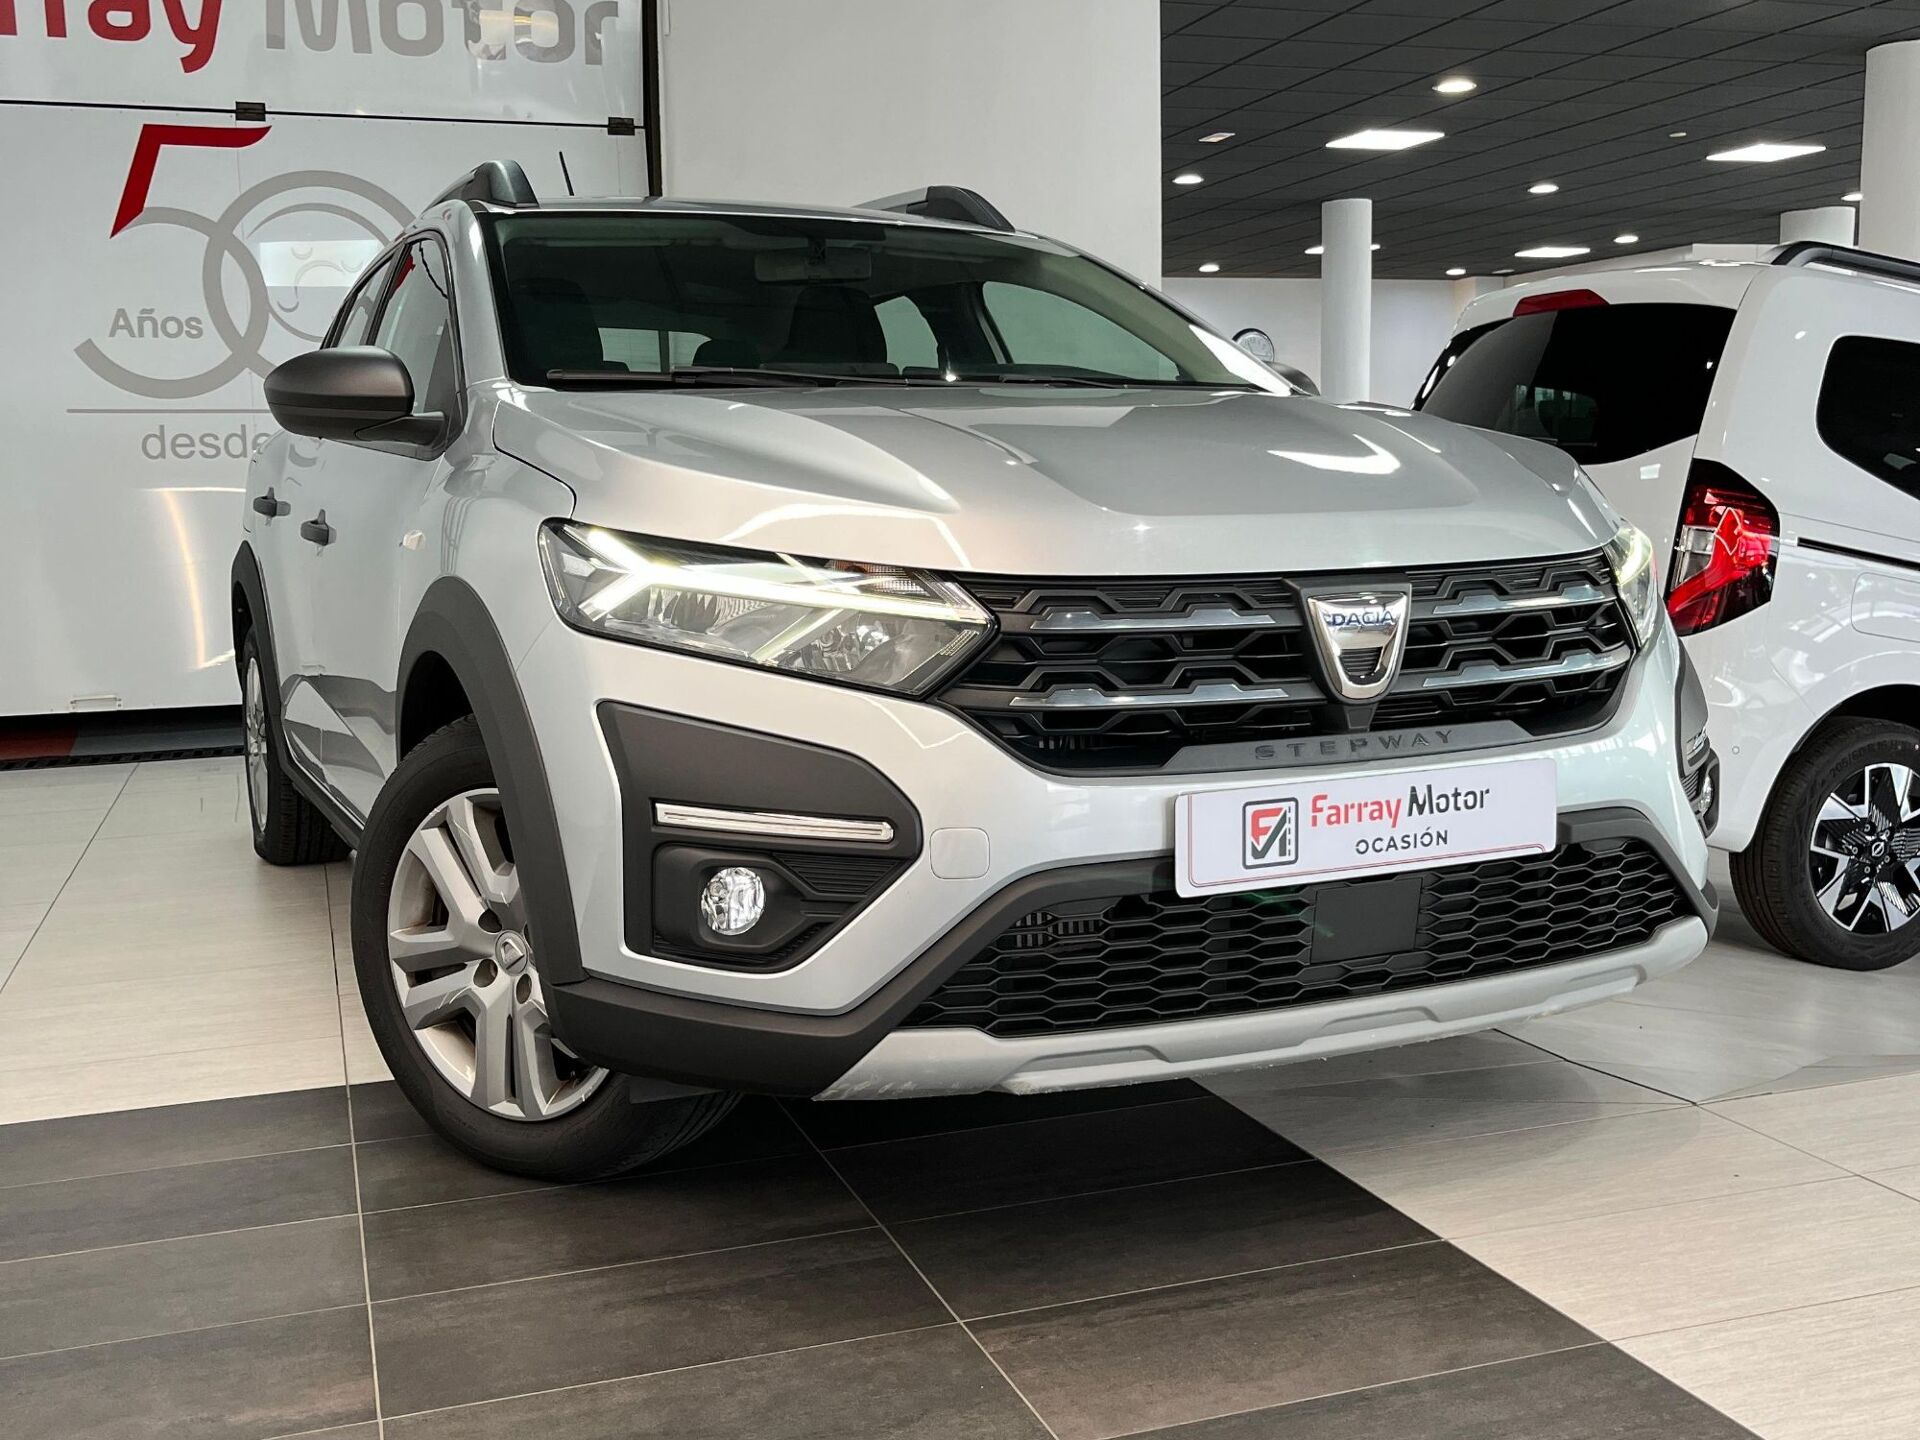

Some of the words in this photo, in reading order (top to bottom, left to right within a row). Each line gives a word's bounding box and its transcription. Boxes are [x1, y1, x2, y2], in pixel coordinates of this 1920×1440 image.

[265, 0, 619, 66] Motor
[107, 307, 204, 339] Años
[1331, 610, 1394, 626] DACIA
[1255, 729, 1453, 761] STEPWAY
[1311, 793, 1402, 828] Farray
[1407, 784, 1490, 817] Motor
[1355, 827, 1449, 855] OCASIÓN
